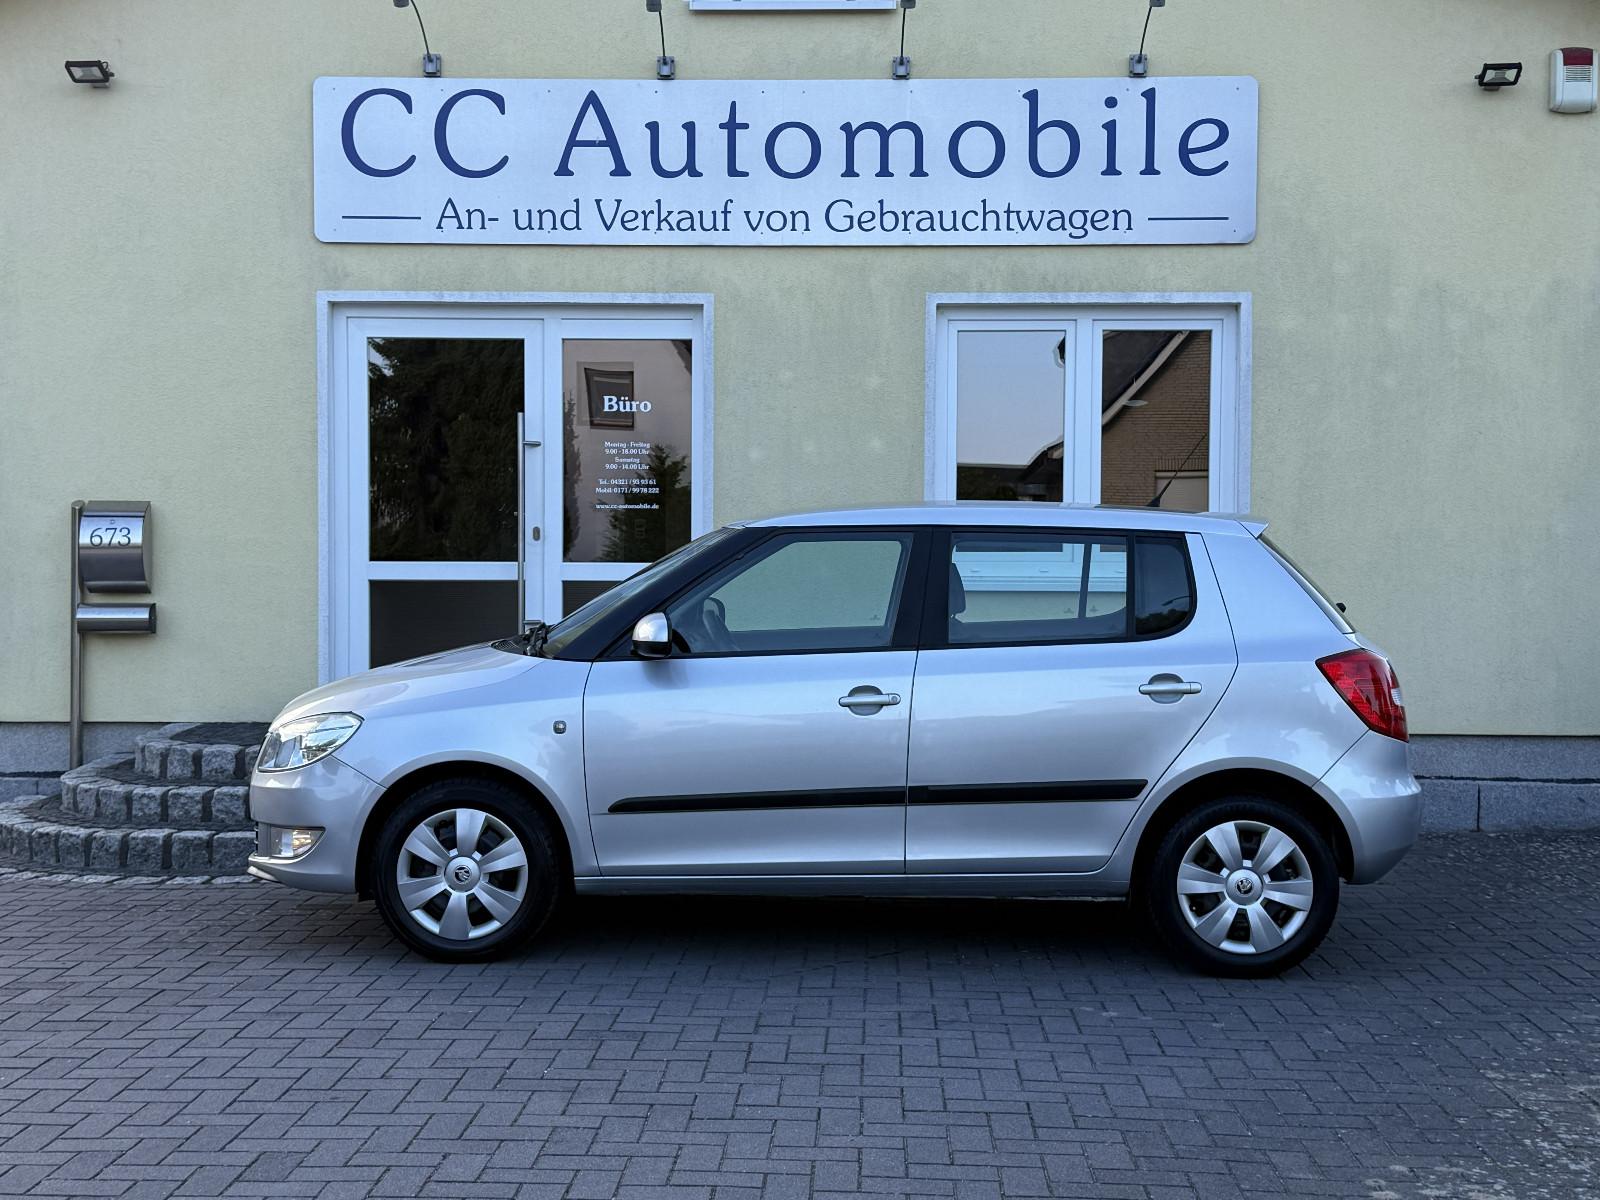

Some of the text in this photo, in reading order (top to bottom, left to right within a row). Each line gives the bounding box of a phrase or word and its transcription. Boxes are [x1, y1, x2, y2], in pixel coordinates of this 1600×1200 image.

[340, 86, 1230, 180] CC Automobile
[435, 196, 1134, 239] An- und Verkauf von Gebrauchtwagen
[603, 395, 652, 412] Büro
[89, 526, 132, 548] 673
